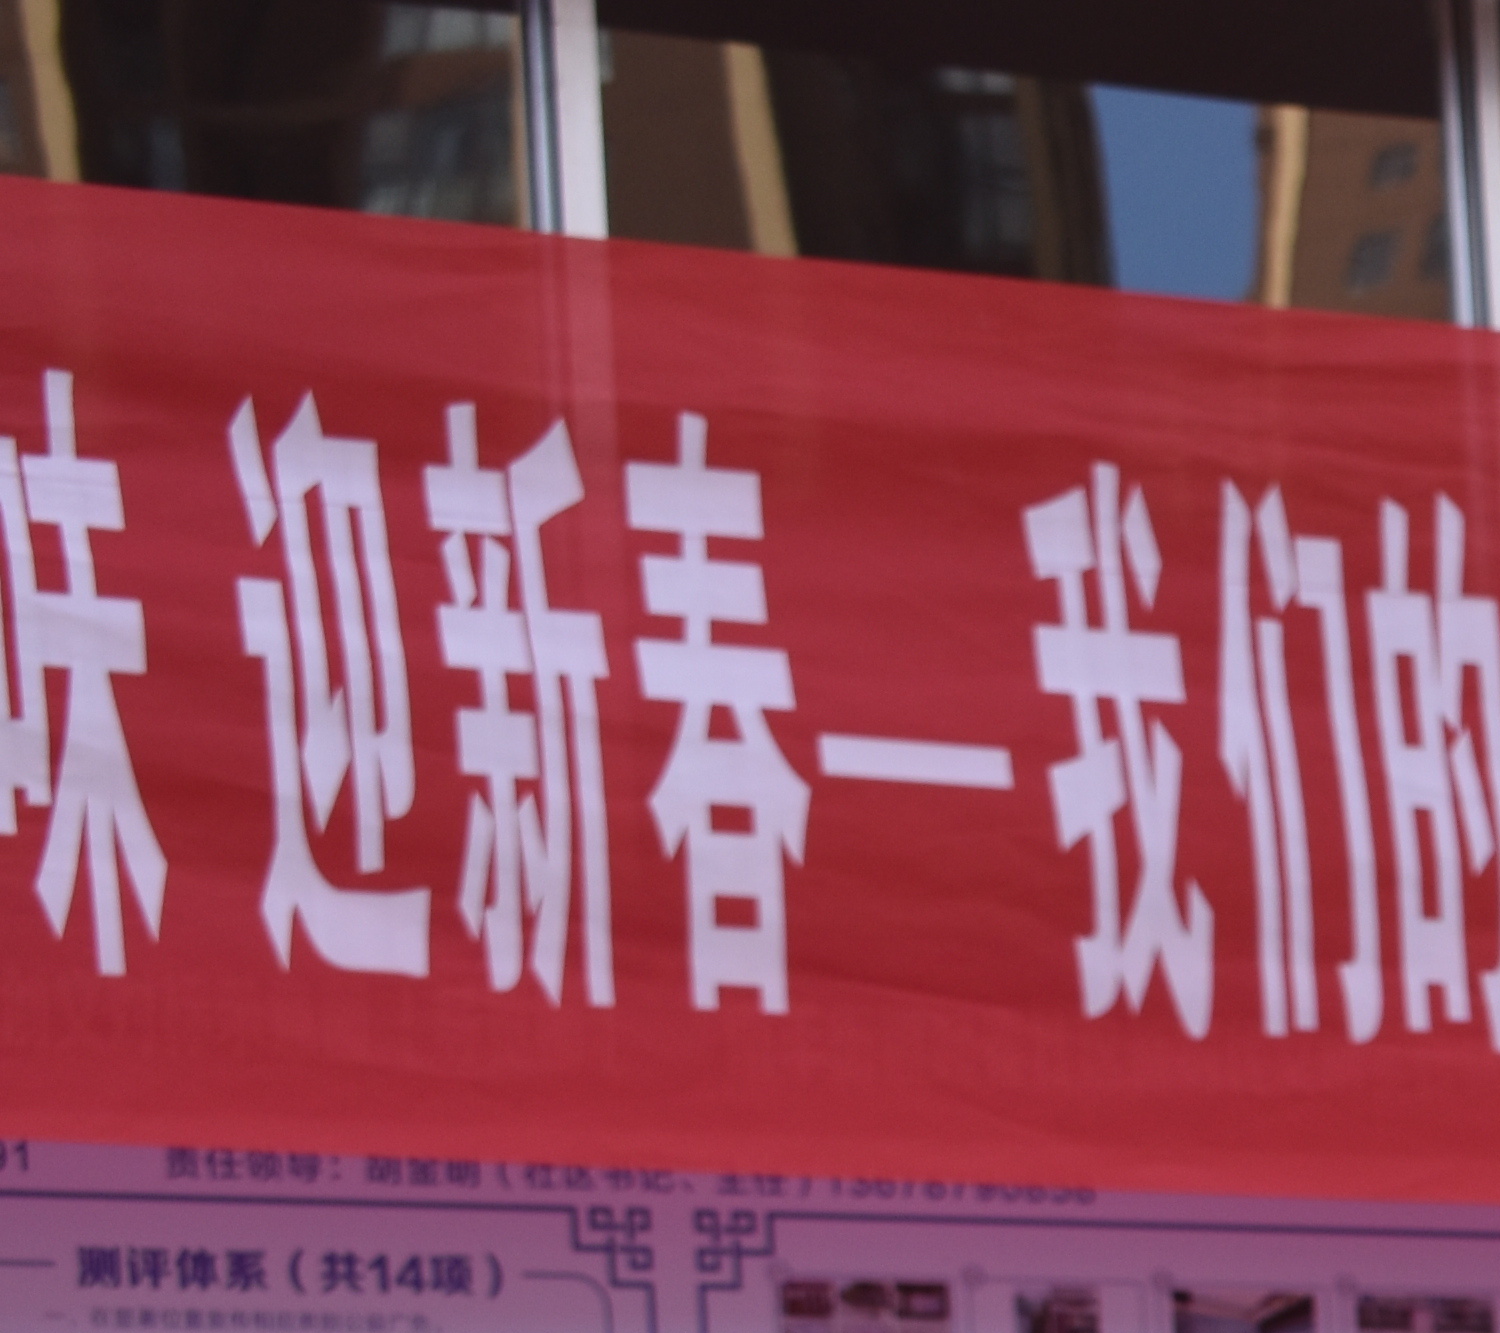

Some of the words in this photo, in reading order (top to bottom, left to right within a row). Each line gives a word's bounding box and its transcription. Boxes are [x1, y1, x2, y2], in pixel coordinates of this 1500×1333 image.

[0, 370, 167, 978] 味
[76, 1243, 507, 1300] 测评体系（共14项）
